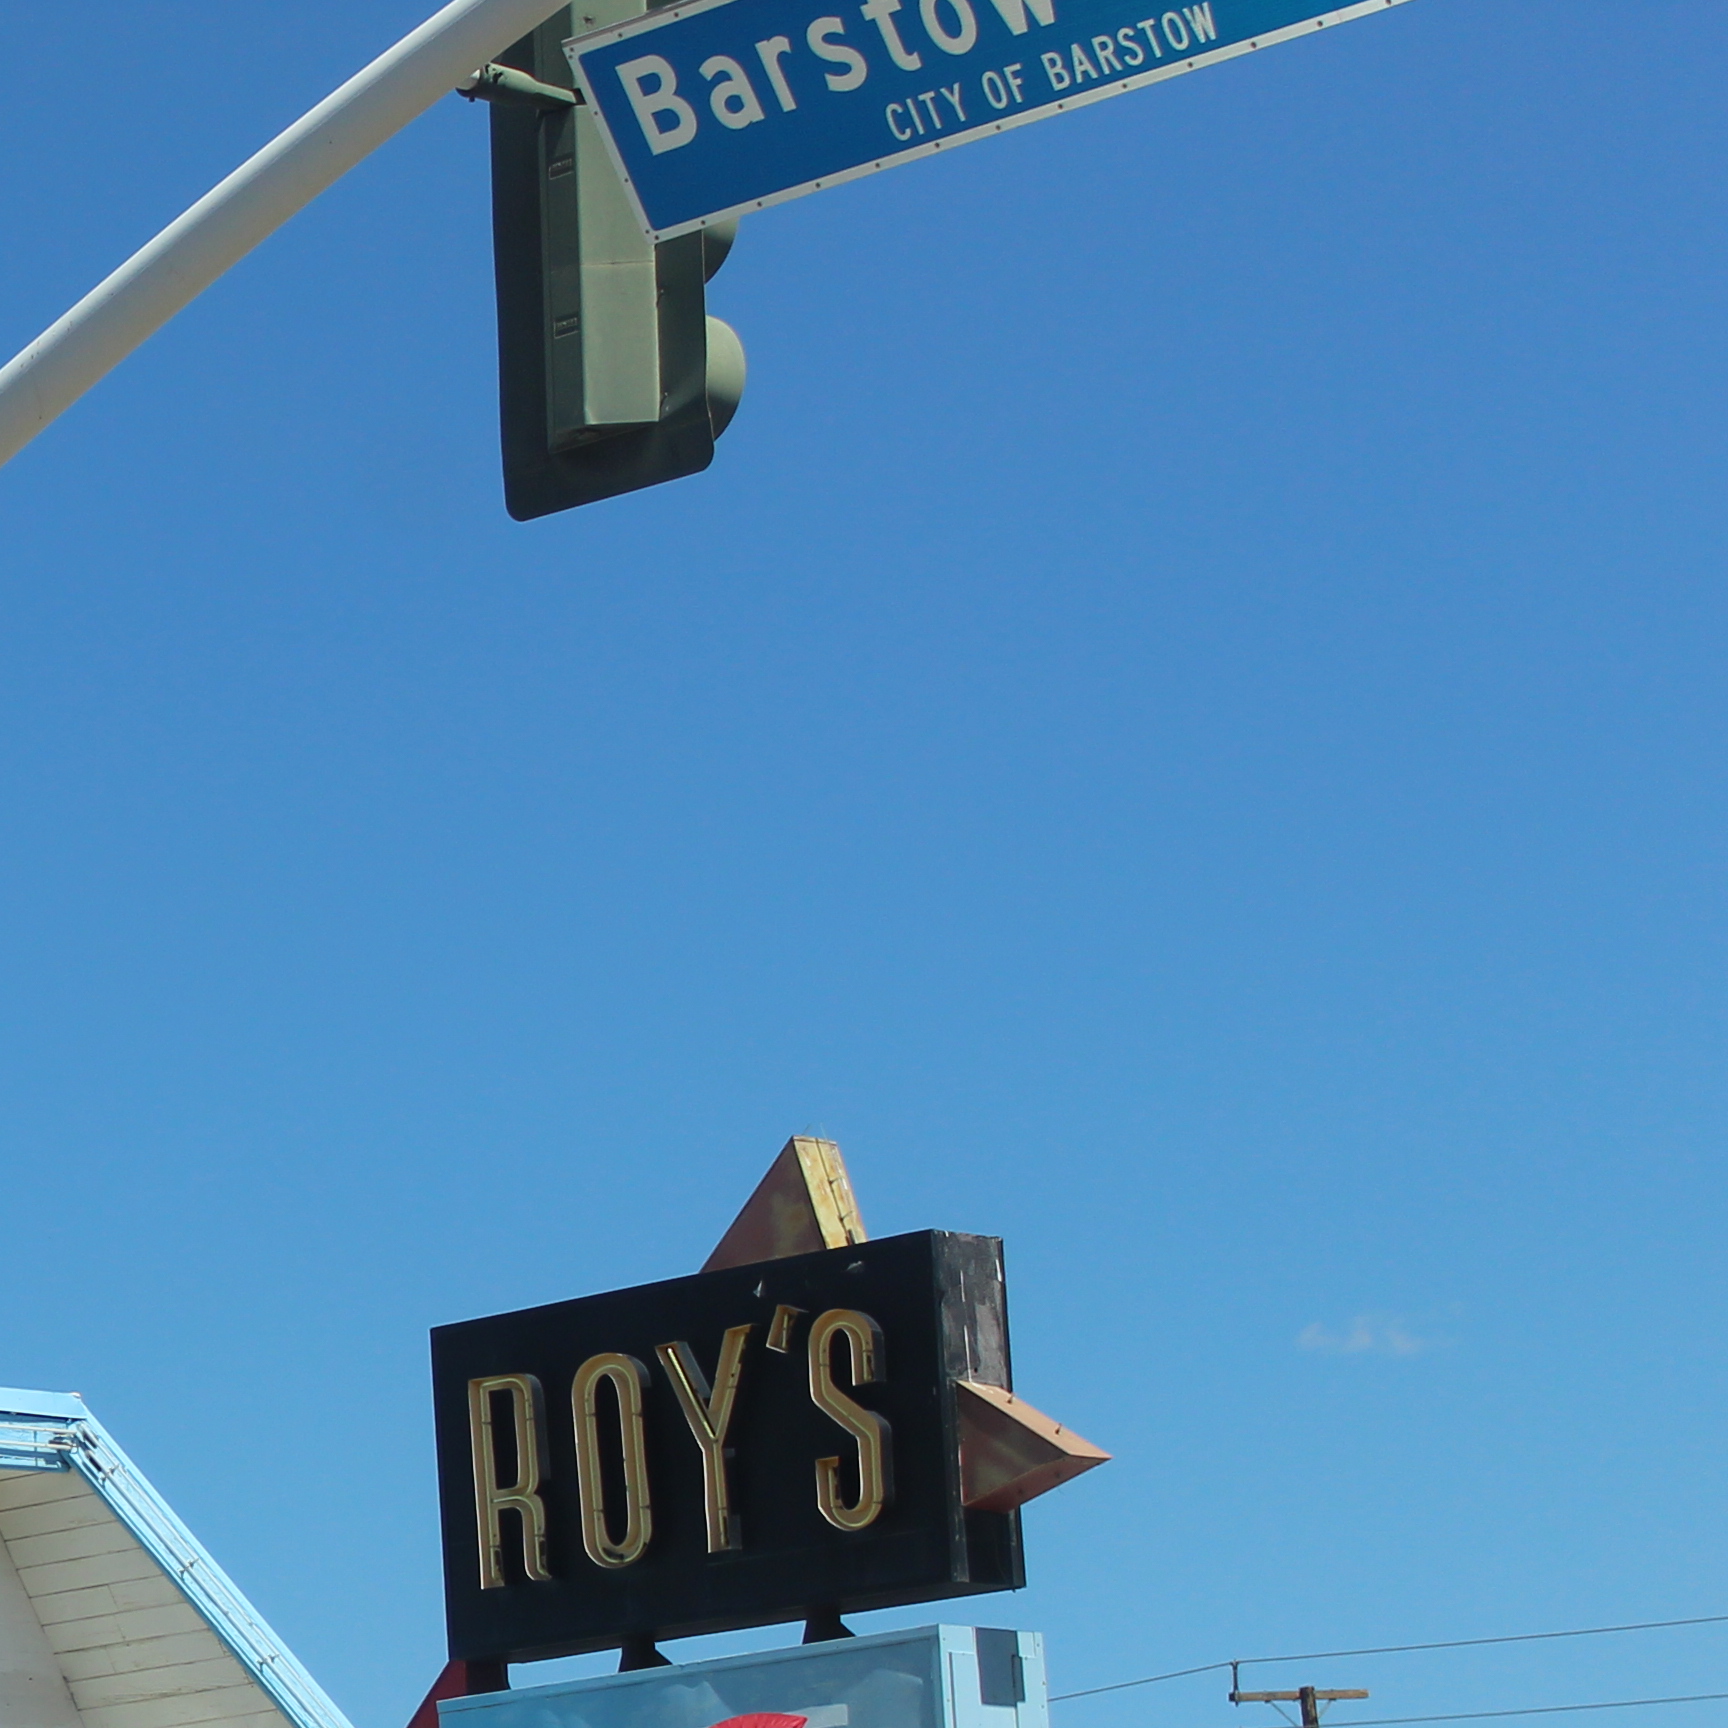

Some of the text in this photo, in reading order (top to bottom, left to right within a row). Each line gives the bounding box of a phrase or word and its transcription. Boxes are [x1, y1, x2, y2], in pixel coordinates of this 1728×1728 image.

[884, 1, 1218, 141] CITY OF BARSTOW
[467, 1303, 890, 1590] ROY'S
